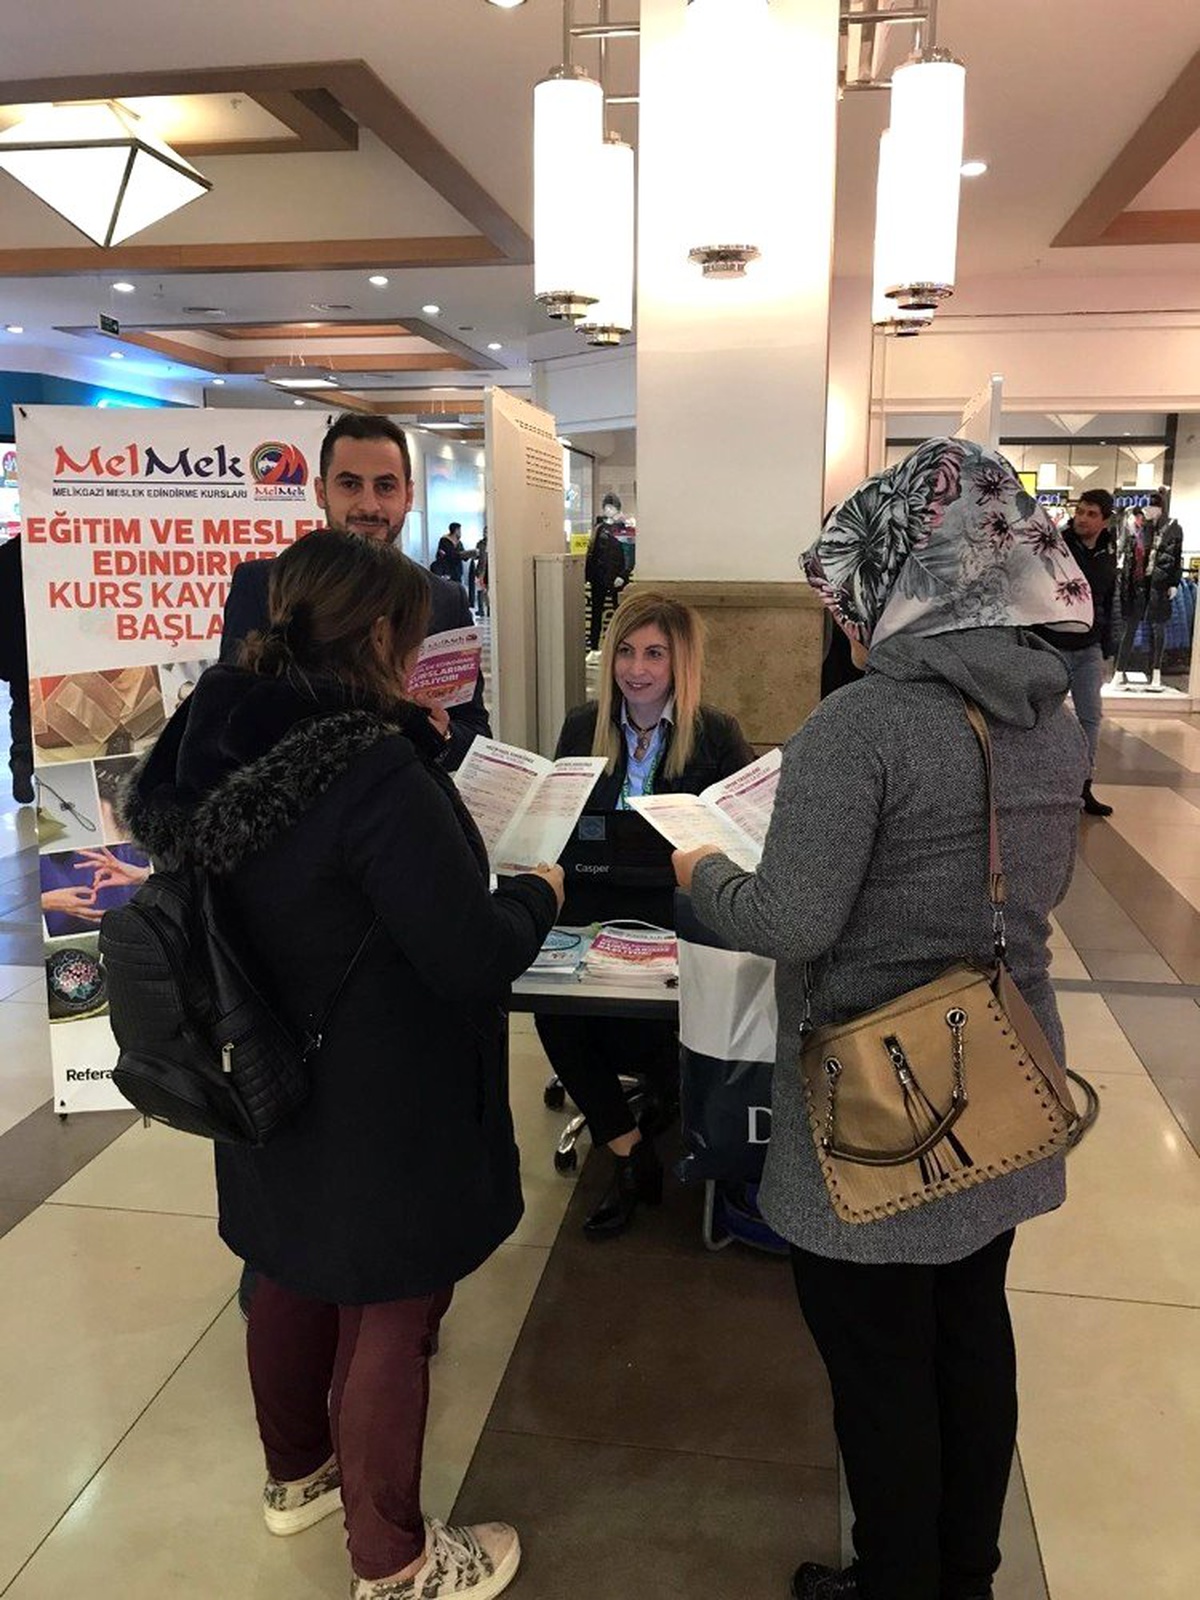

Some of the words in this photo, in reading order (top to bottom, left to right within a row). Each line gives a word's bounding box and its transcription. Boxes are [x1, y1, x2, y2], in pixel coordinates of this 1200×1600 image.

[106, 488, 145, 498] MESLEK
[200, 489, 247, 498] KURSLARI
[150, 518, 194, 544] VE
[202, 519, 327, 544] MESLE
[49, 581, 143, 609] KURS
[151, 582, 232, 609] KAYI
[575, 863, 610, 875] Casper
